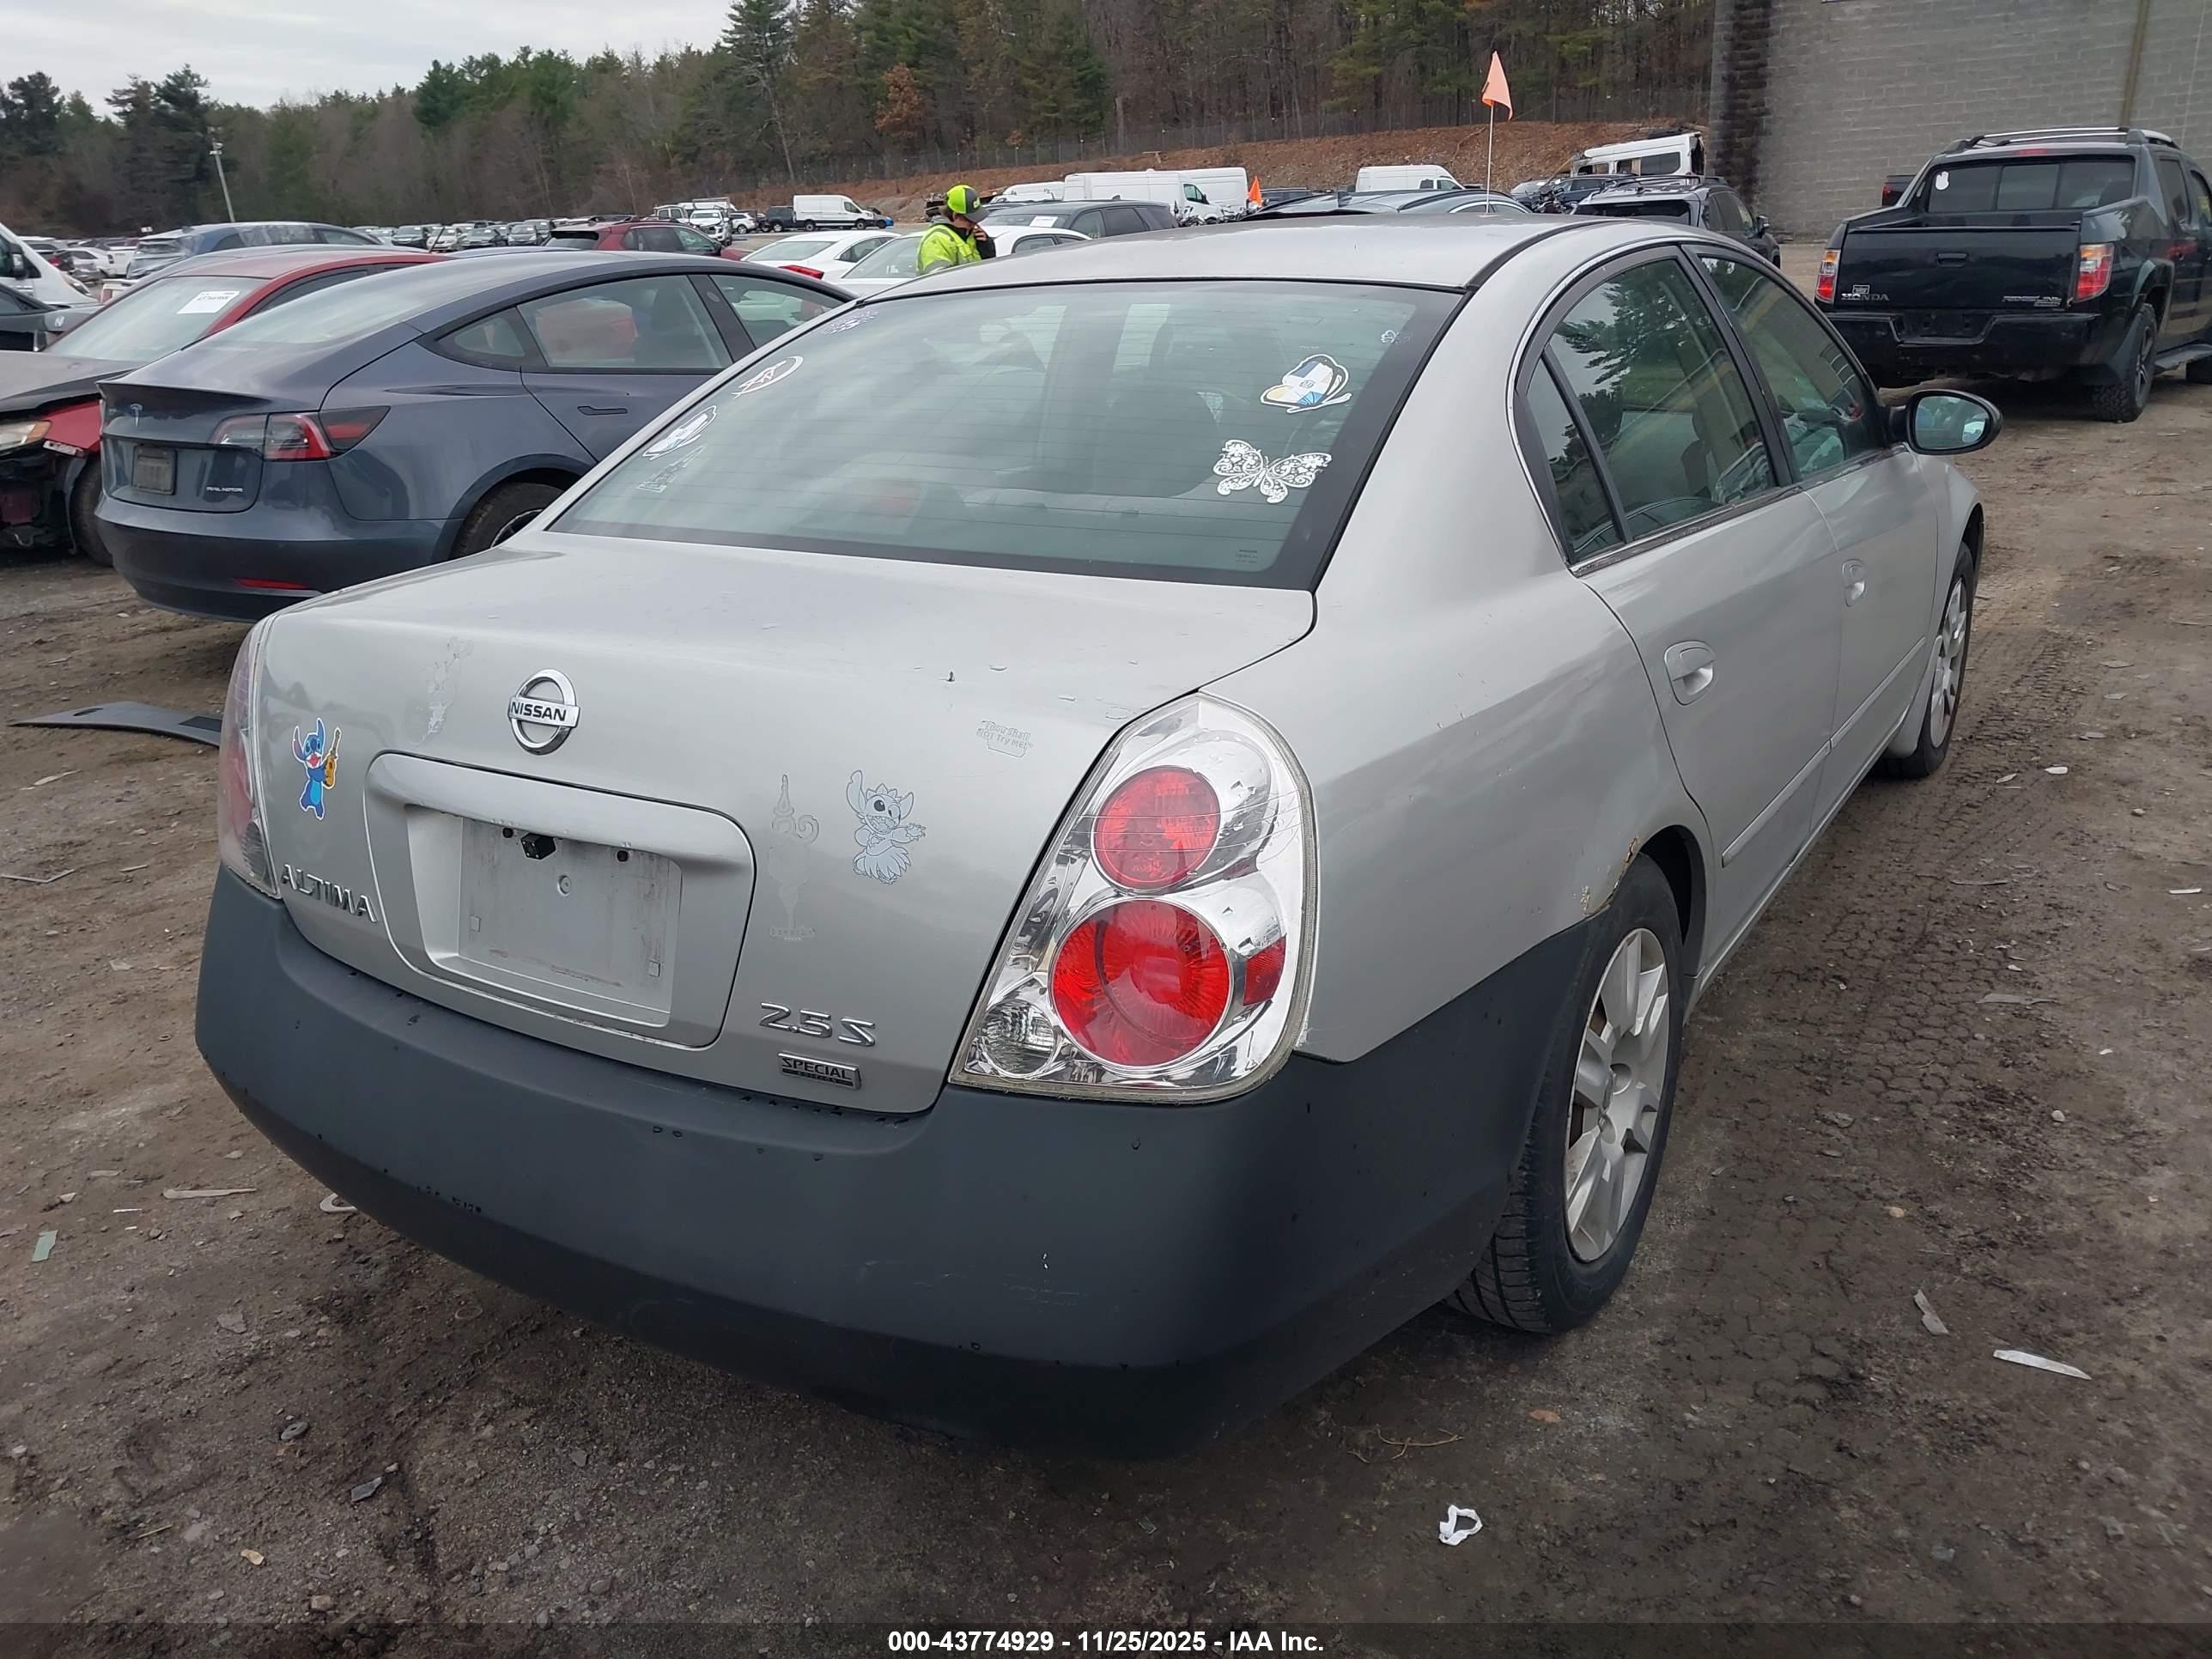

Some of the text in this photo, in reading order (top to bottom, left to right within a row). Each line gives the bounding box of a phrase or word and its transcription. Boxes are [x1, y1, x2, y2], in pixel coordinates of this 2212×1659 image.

[510, 701, 567, 722] NISSAN
[281, 863, 378, 923] ALTIMA
[759, 1001, 876, 1048] 2.5 S
[781, 1057, 853, 1081] SPECIAL
